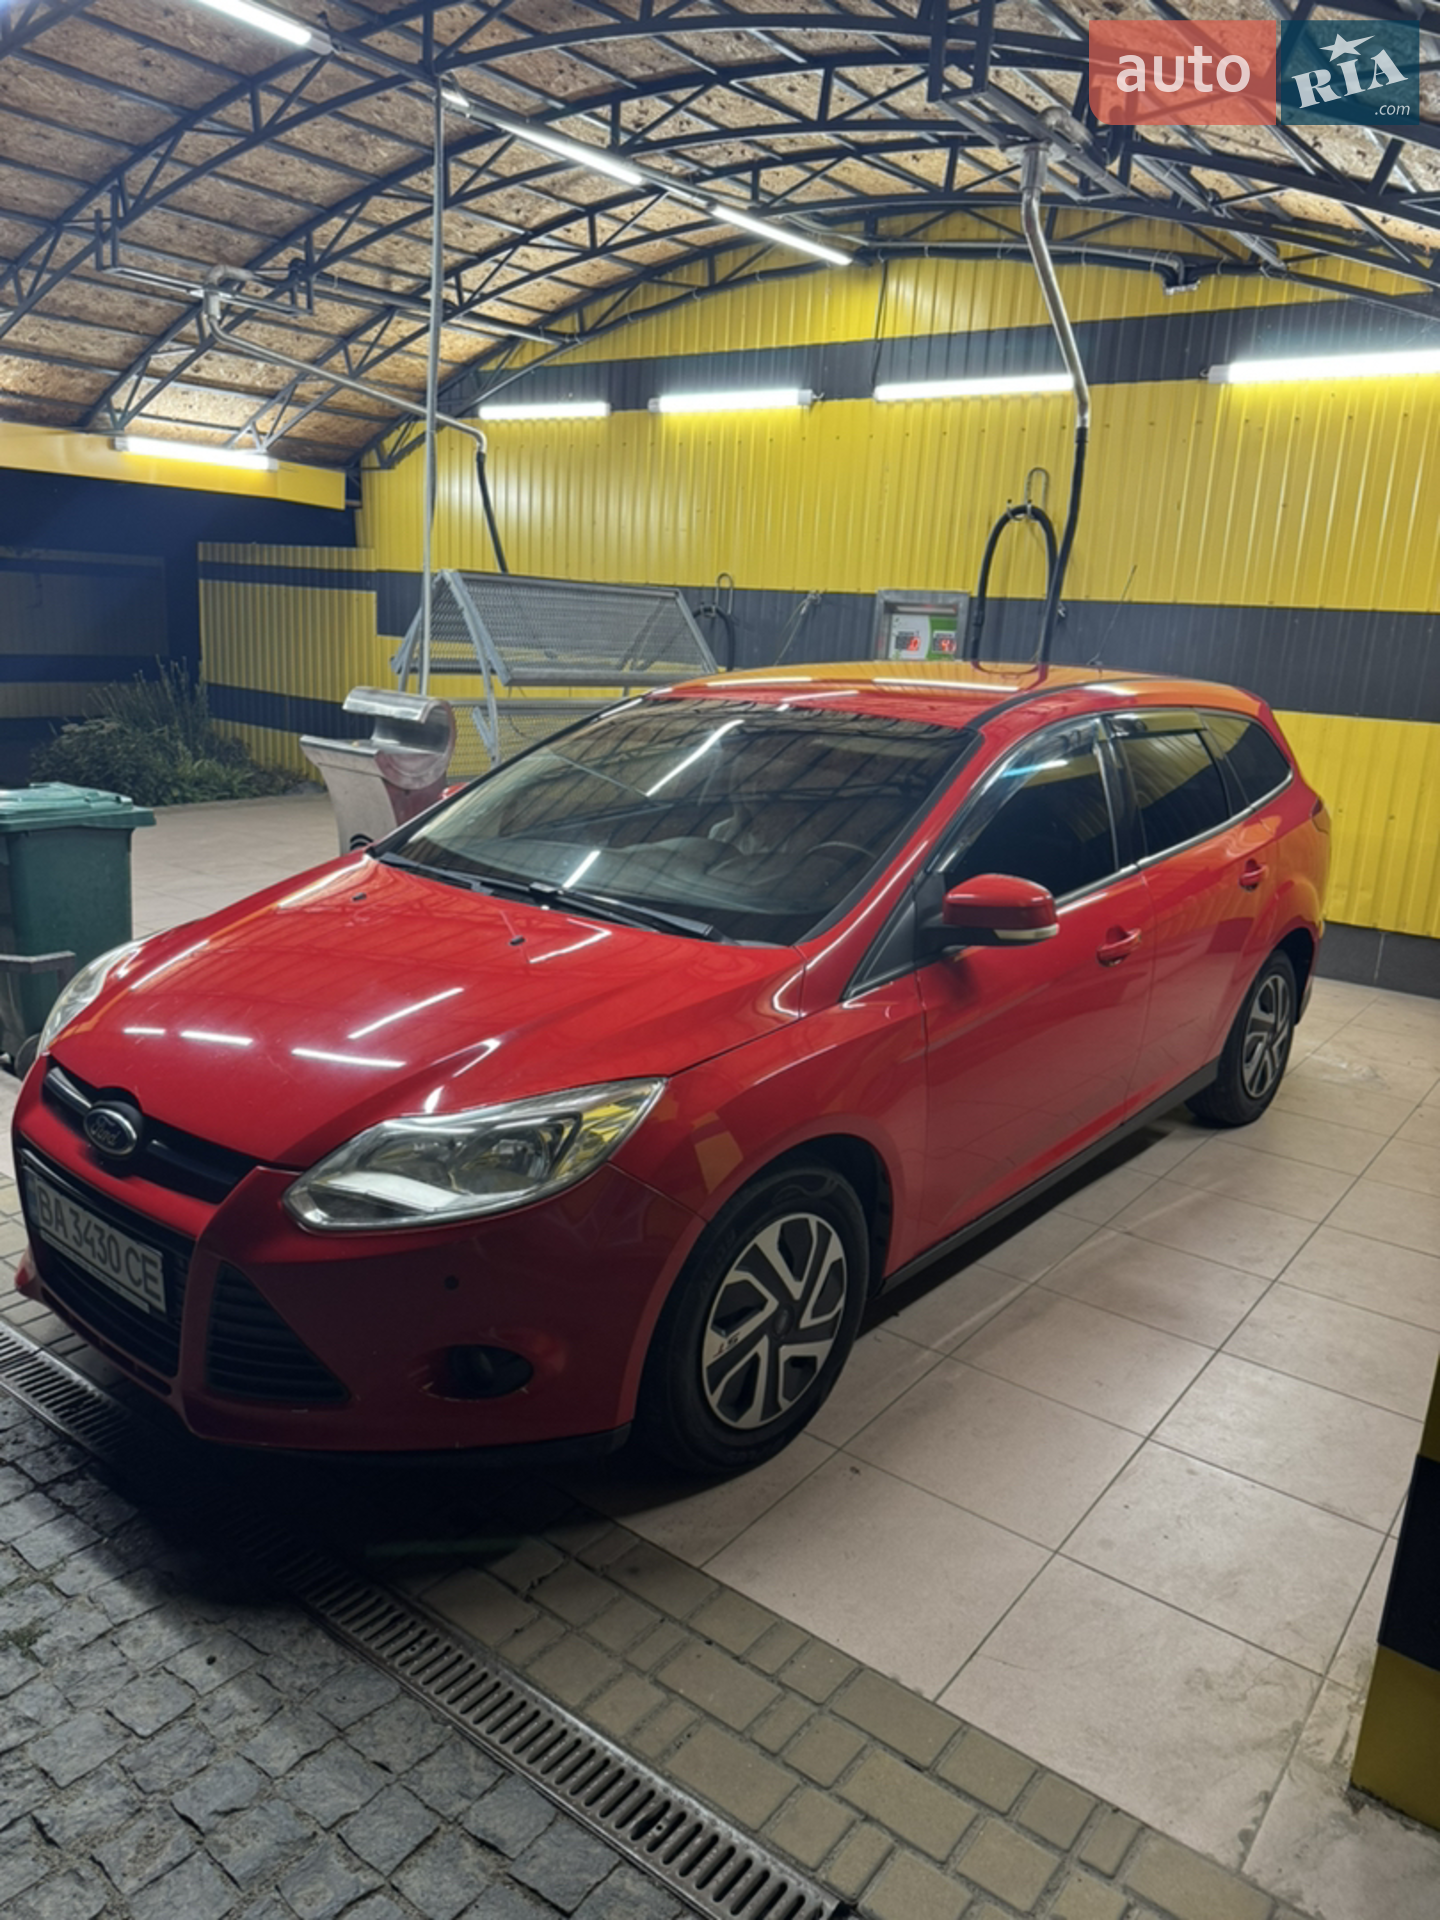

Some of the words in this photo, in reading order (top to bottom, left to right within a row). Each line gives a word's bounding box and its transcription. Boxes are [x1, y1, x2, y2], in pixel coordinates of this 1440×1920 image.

[89, 1114, 122, 1147] Ford
[37, 1185, 69, 1239] BA
[69, 1207, 122, 1275] 3430
[125, 1247, 162, 1302] CE
